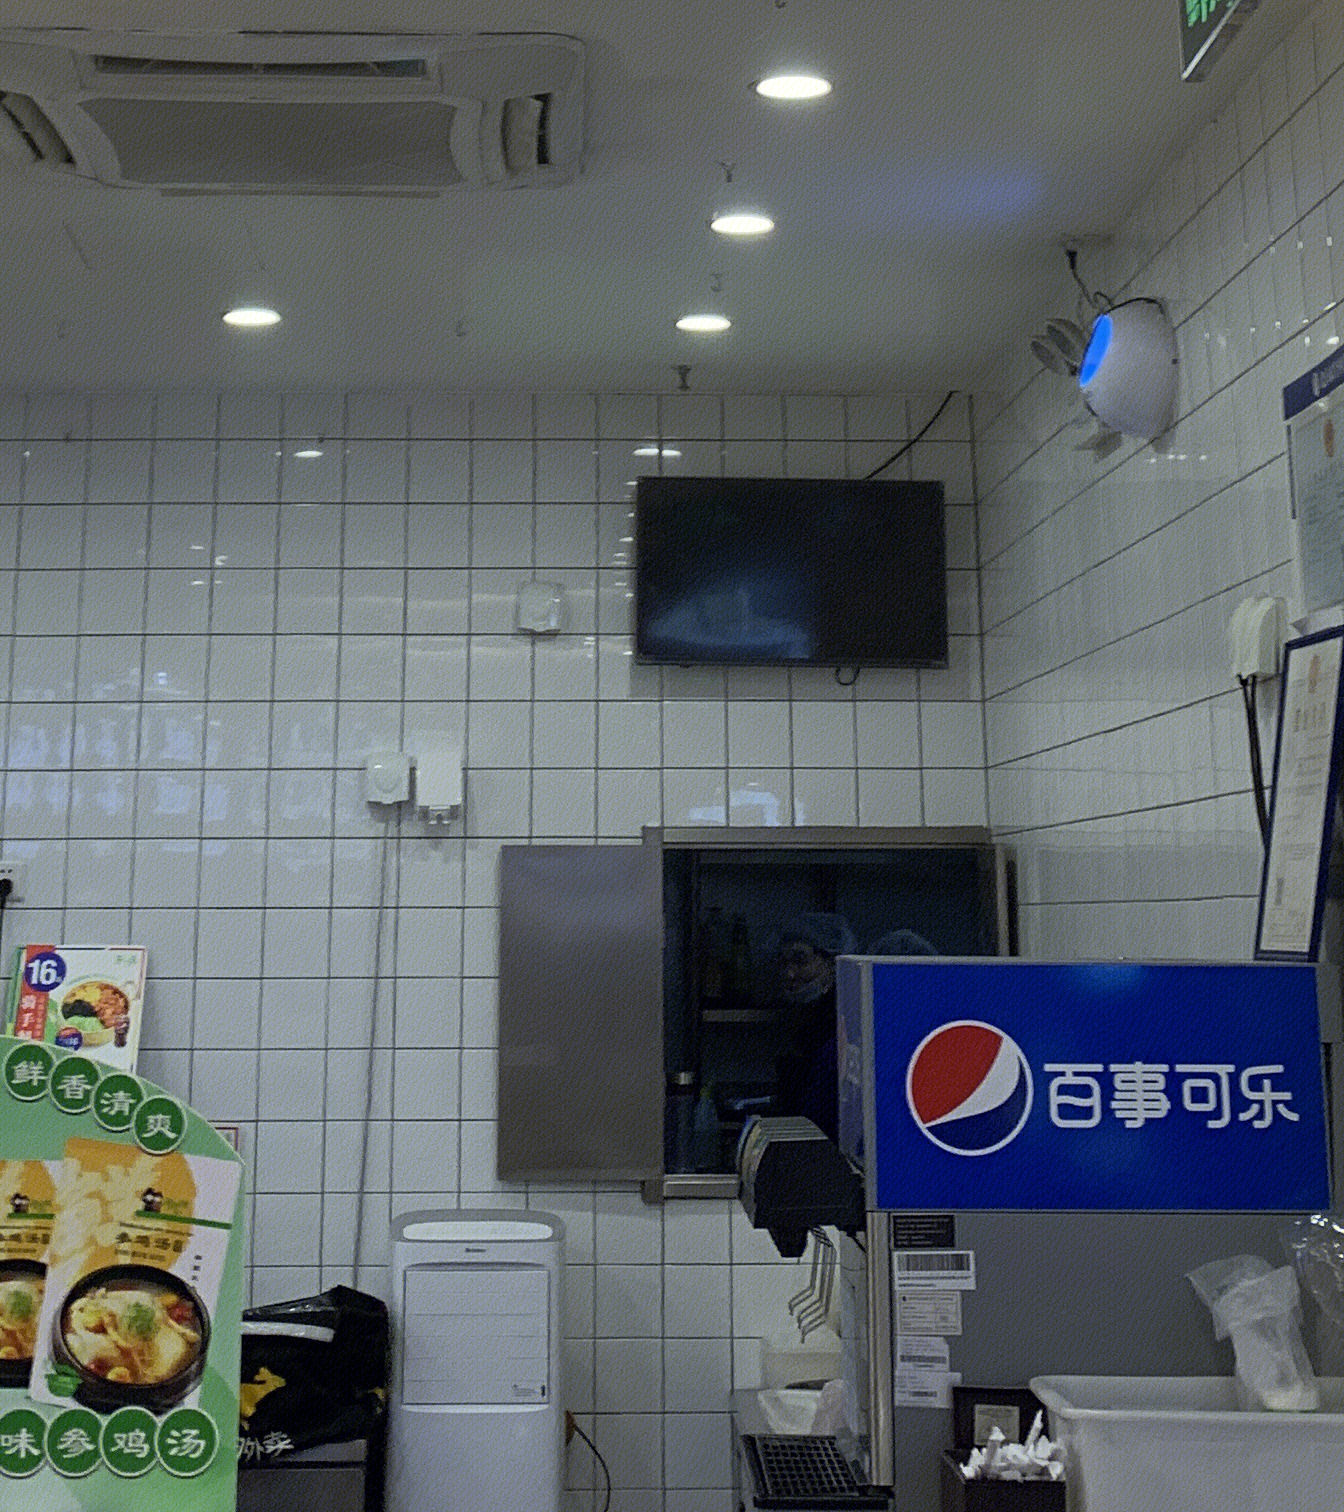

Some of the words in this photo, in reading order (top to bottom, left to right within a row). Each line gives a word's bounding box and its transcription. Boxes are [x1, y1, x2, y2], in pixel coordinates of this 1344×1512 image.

[10, 1058, 179, 1141] 鲜香清爽
[1043, 1060, 1300, 1129] 百事可乐
